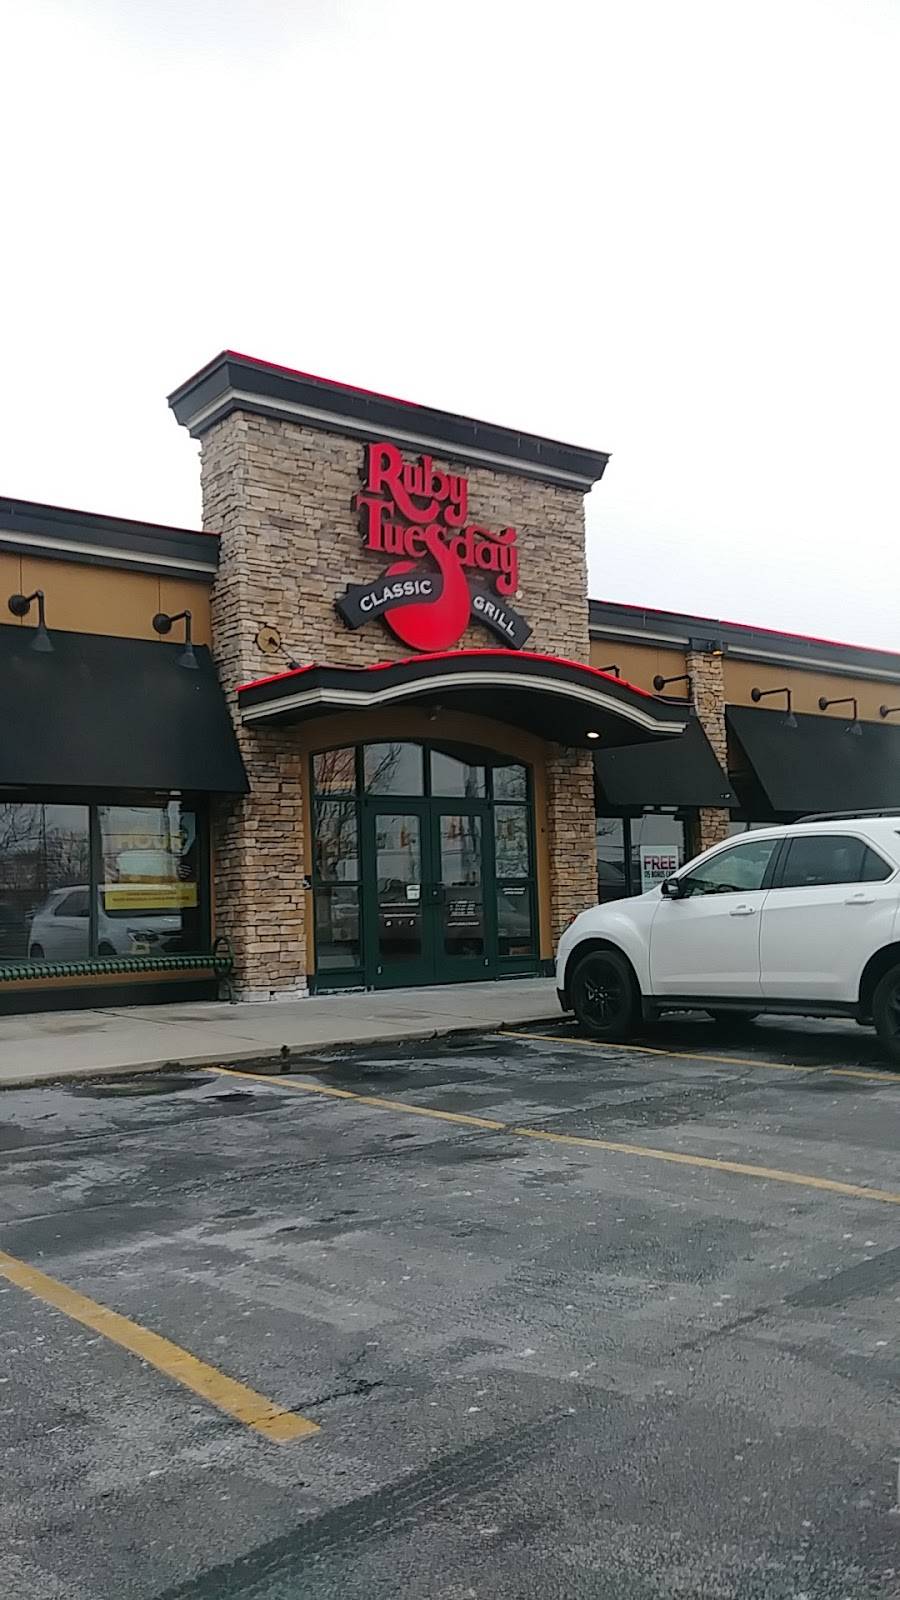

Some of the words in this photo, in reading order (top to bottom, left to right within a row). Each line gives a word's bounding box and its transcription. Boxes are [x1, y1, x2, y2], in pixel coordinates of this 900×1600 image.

[369, 442, 469, 527] Ruby
[356, 496, 519, 597] Tuesday
[360, 580, 433, 612] CLASSIC
[473, 596, 516, 637] GRILL
[643, 855, 676, 870] FREE
